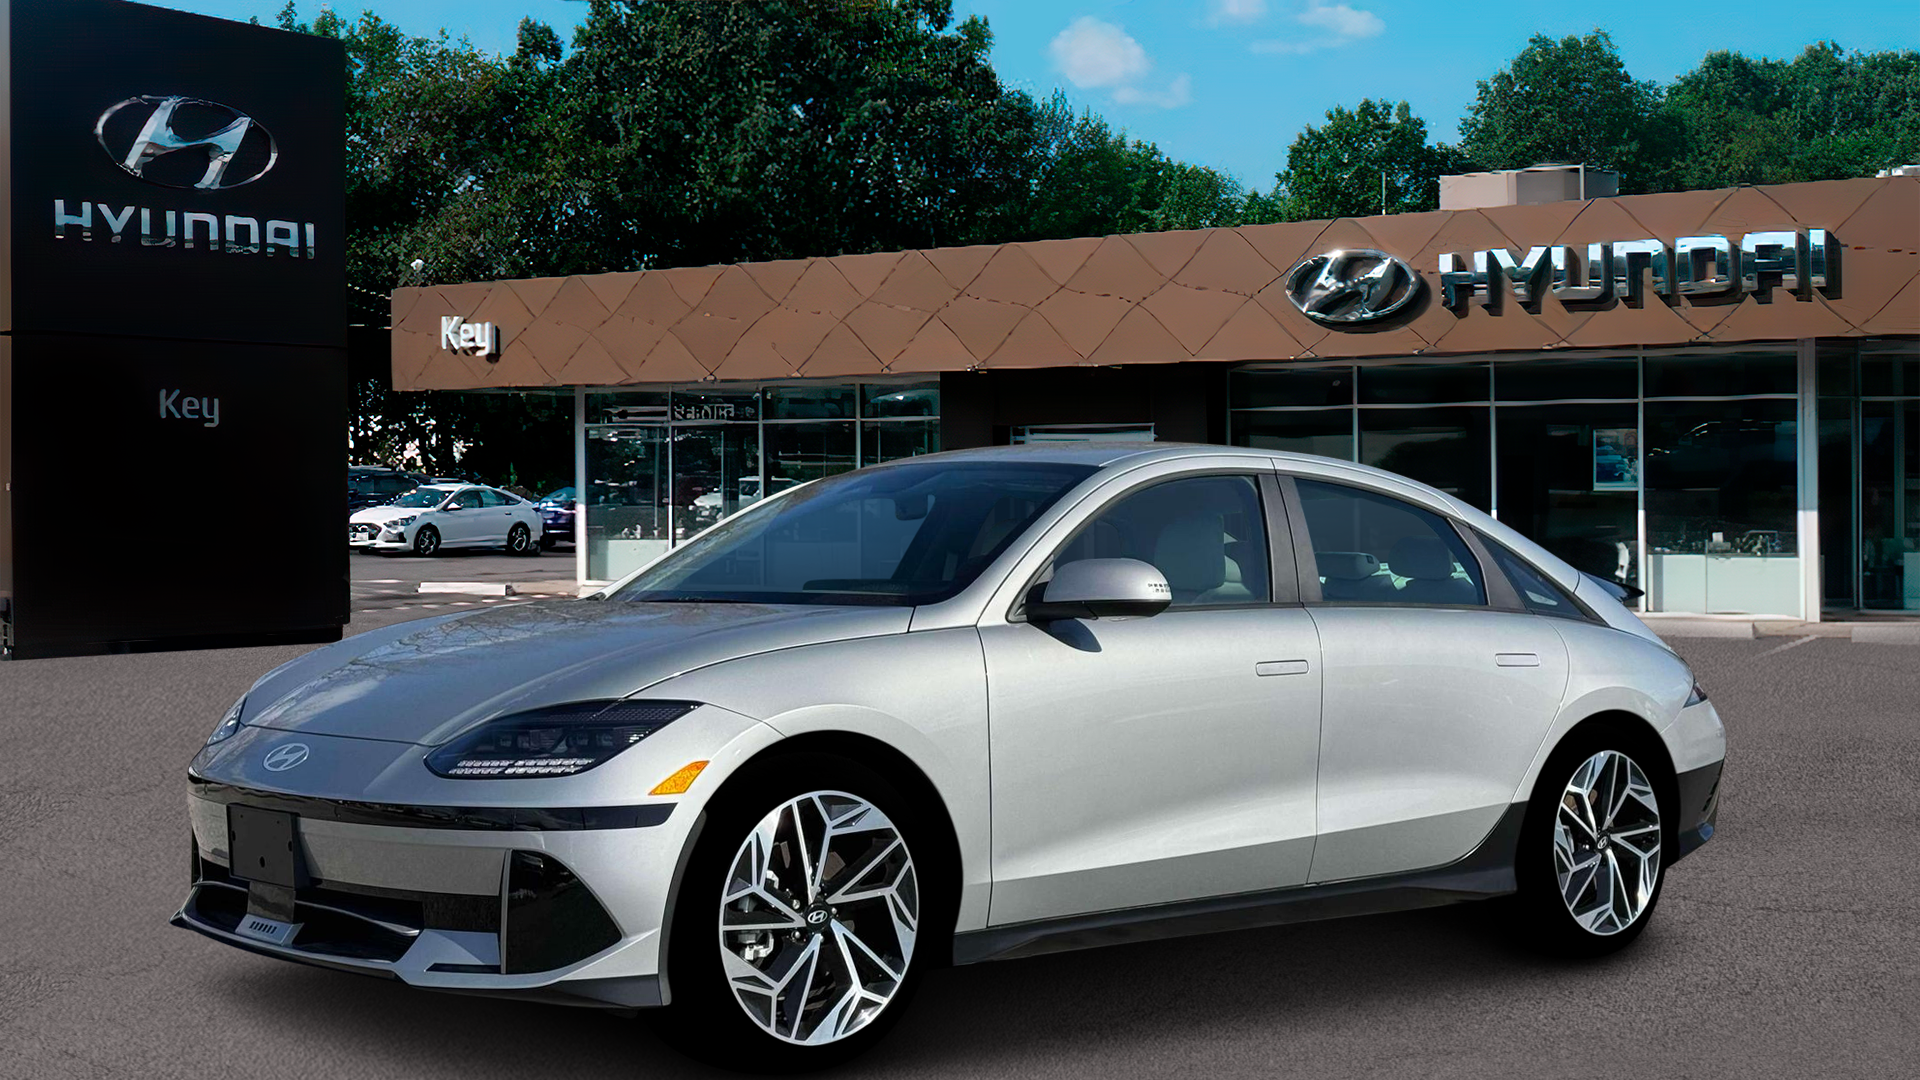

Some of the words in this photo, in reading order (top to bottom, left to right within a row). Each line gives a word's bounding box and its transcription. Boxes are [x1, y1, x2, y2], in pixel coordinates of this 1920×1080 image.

[54, 199, 315, 260] HYUNDAI
[1438, 228, 1838, 311] HYUNDAI
[440, 315, 495, 358] Key
[159, 389, 220, 428] Key
